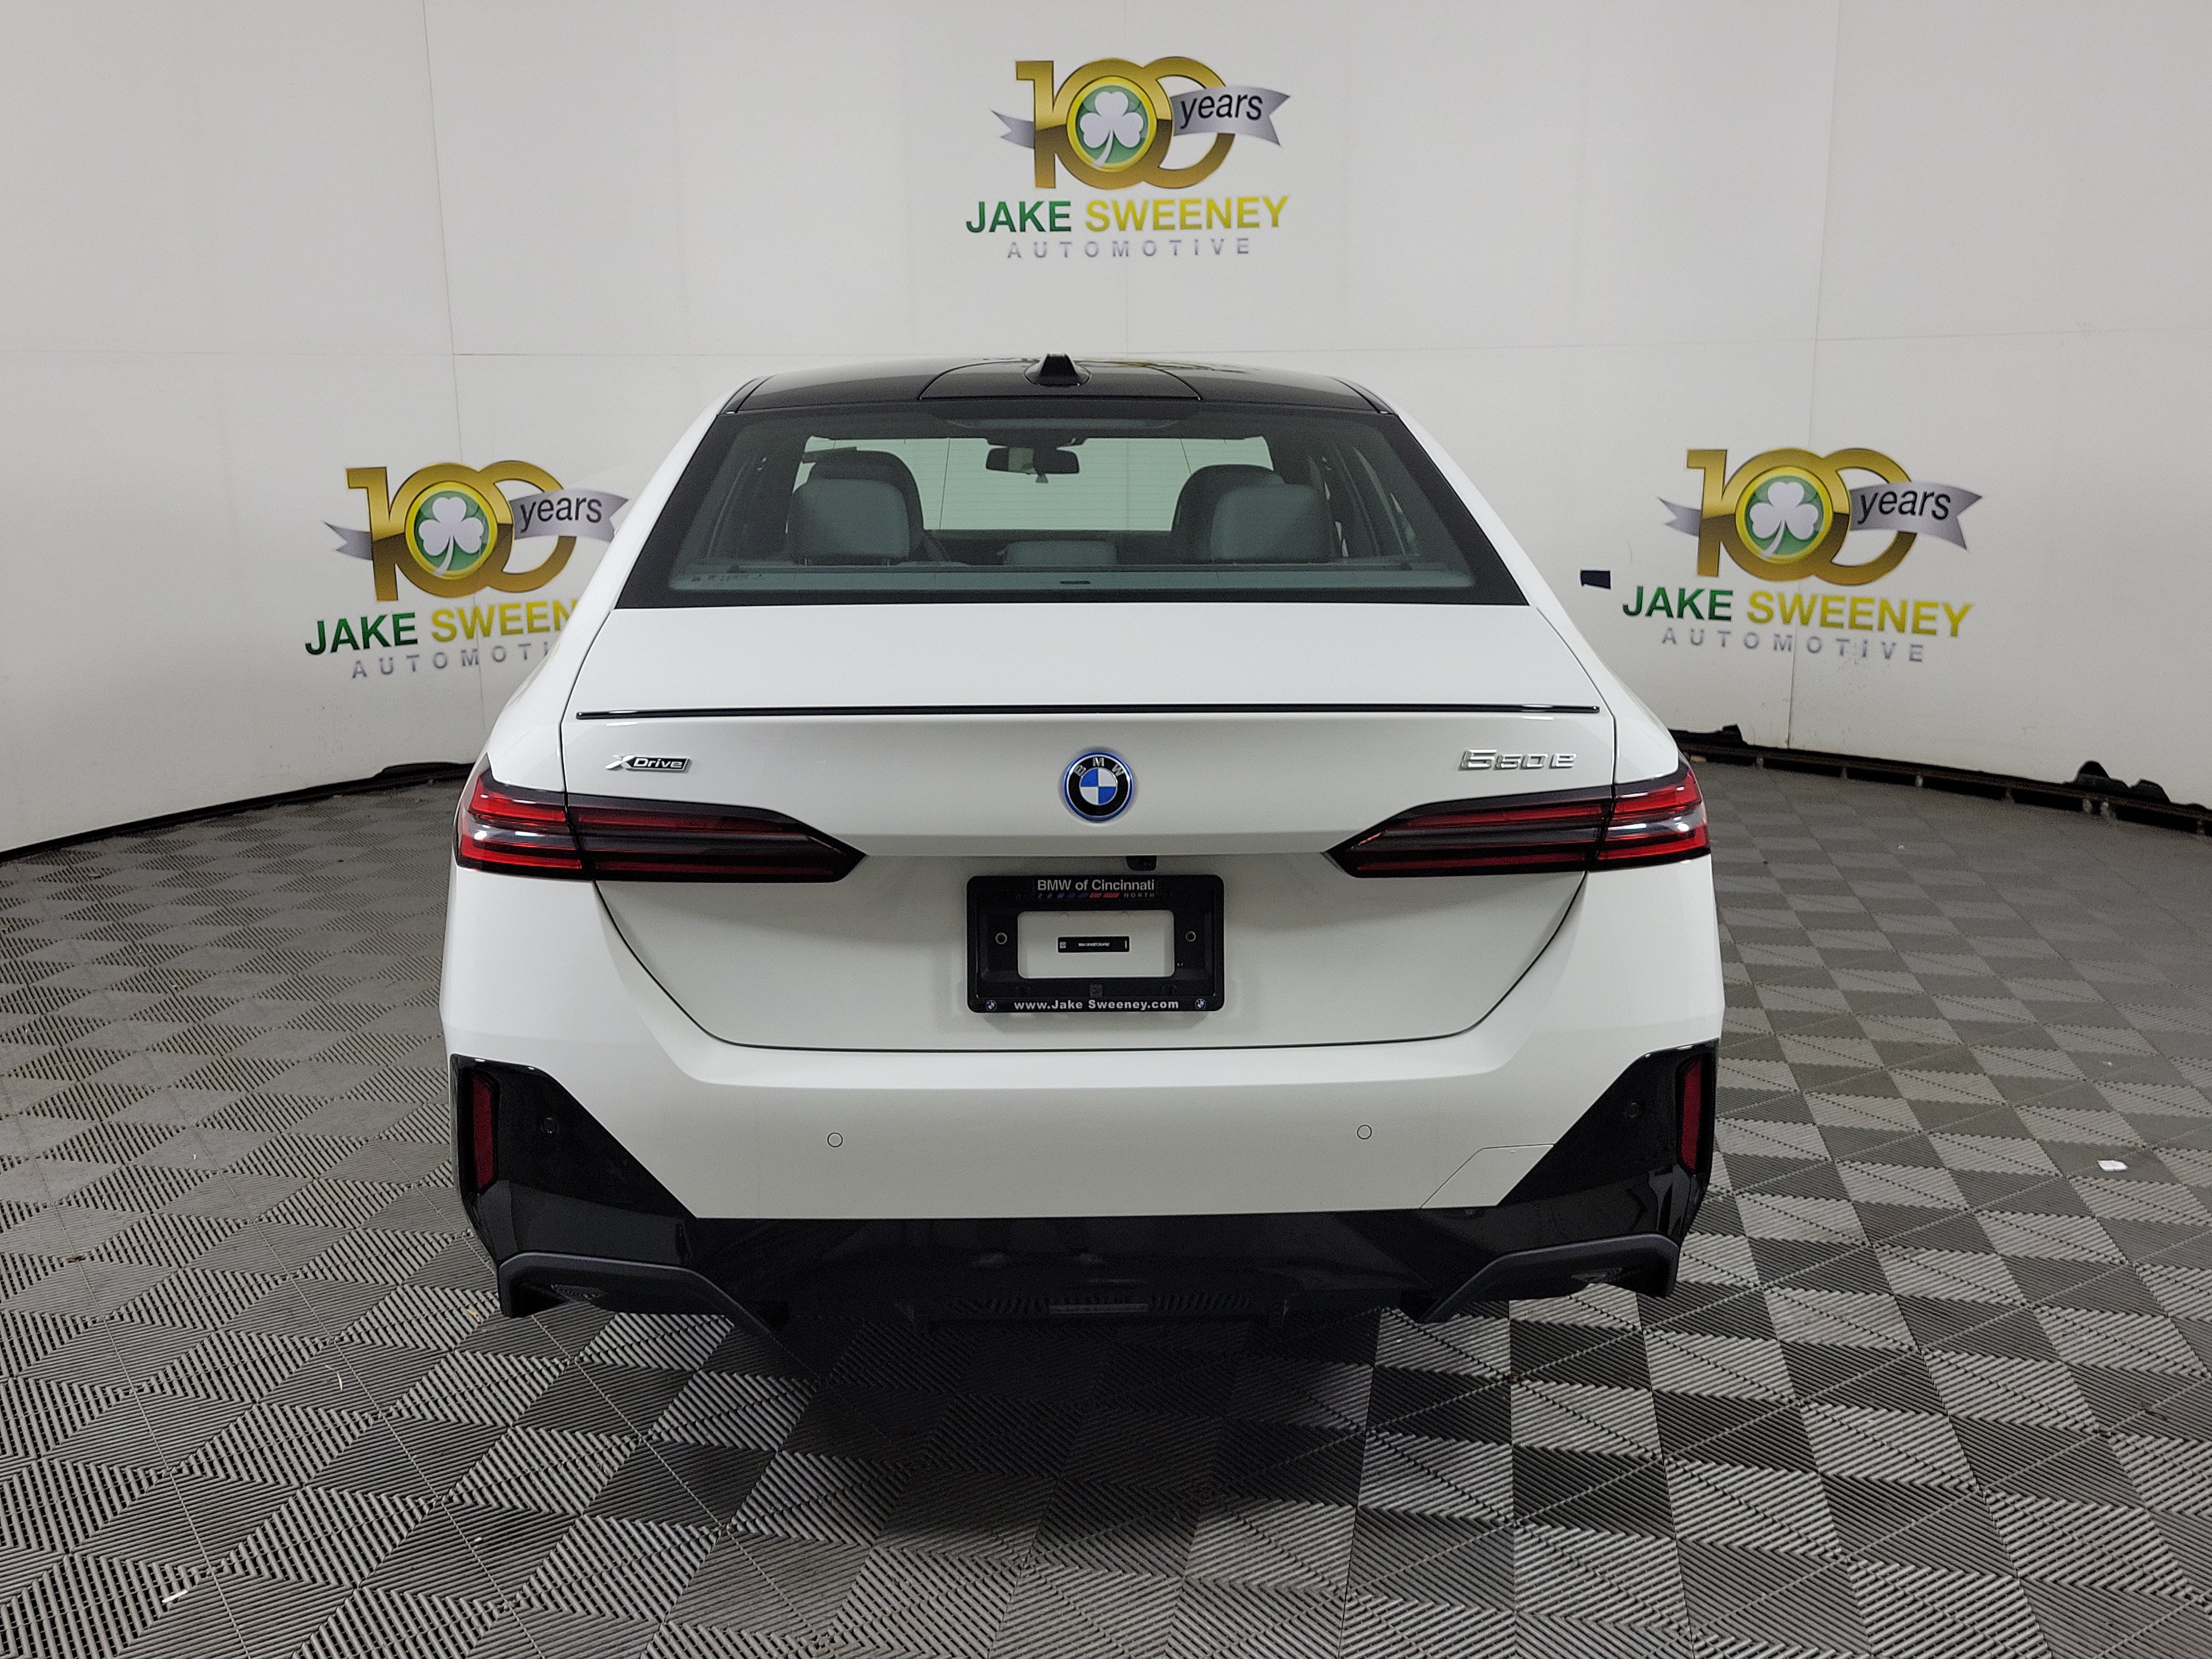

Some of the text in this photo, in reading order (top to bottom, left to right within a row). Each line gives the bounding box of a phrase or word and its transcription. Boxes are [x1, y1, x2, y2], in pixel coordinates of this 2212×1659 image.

[1015, 56, 1263, 189] 100 years
[966, 195, 1288, 233] JAKE SWEENEY
[1008, 238, 1250, 258] AUTOMOTIVE
[346, 460, 602, 602] 100 years
[1686, 448, 1951, 586] 100 years
[1622, 585, 1972, 637] JAKE SWEENEY
[305, 613, 417, 655] JAKE
[1662, 627, 1923, 663] AUTOMOTIVE
[1073, 757, 1125, 777] BMW
[1037, 879, 1154, 890] BMW of Cincinnati
[1088, 999, 1179, 1011] Sweeney.com
